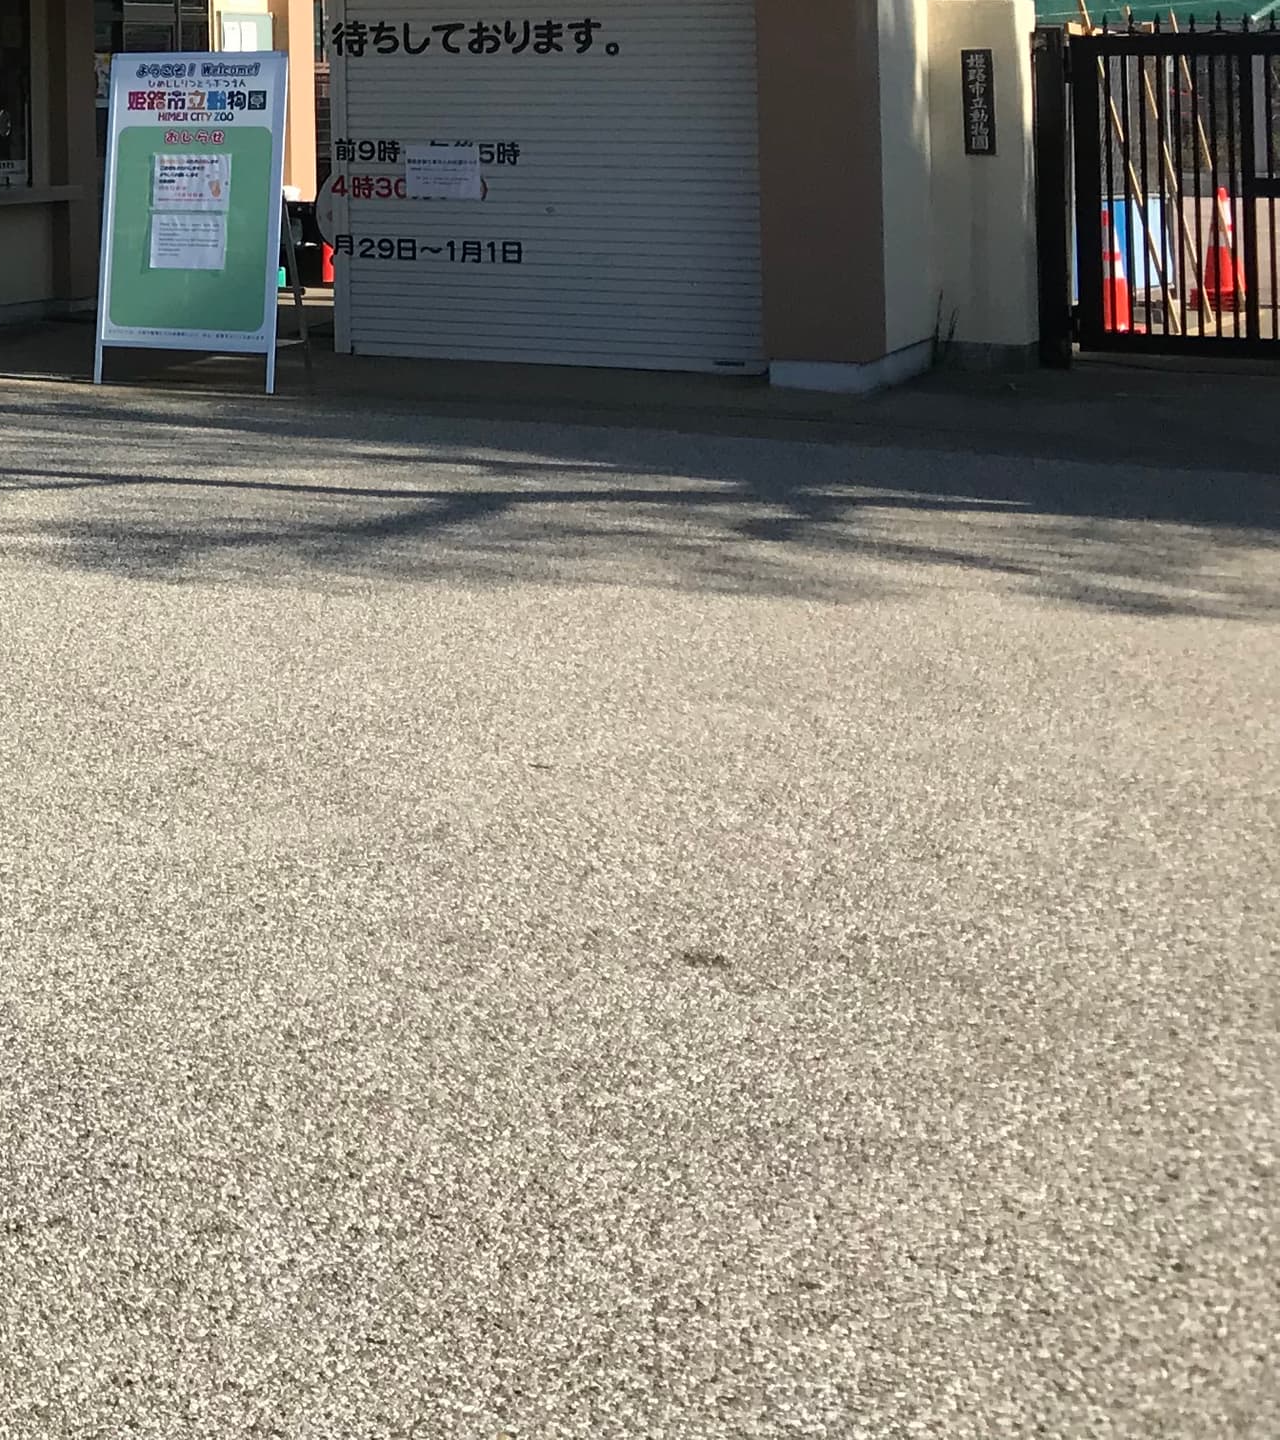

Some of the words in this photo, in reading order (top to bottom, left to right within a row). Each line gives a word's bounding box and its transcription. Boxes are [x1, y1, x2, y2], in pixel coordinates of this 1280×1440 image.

[332, 17, 619, 57] 待ちしております。
[200, 63, 261, 77] Welcome!
[127, 90, 267, 111] 姫路市立動物園
[158, 111, 188, 122] HIMEJI
[190, 111, 213, 122] CITY
[214, 111, 234, 122] ZOO
[164, 130, 225, 145] おしらせ
